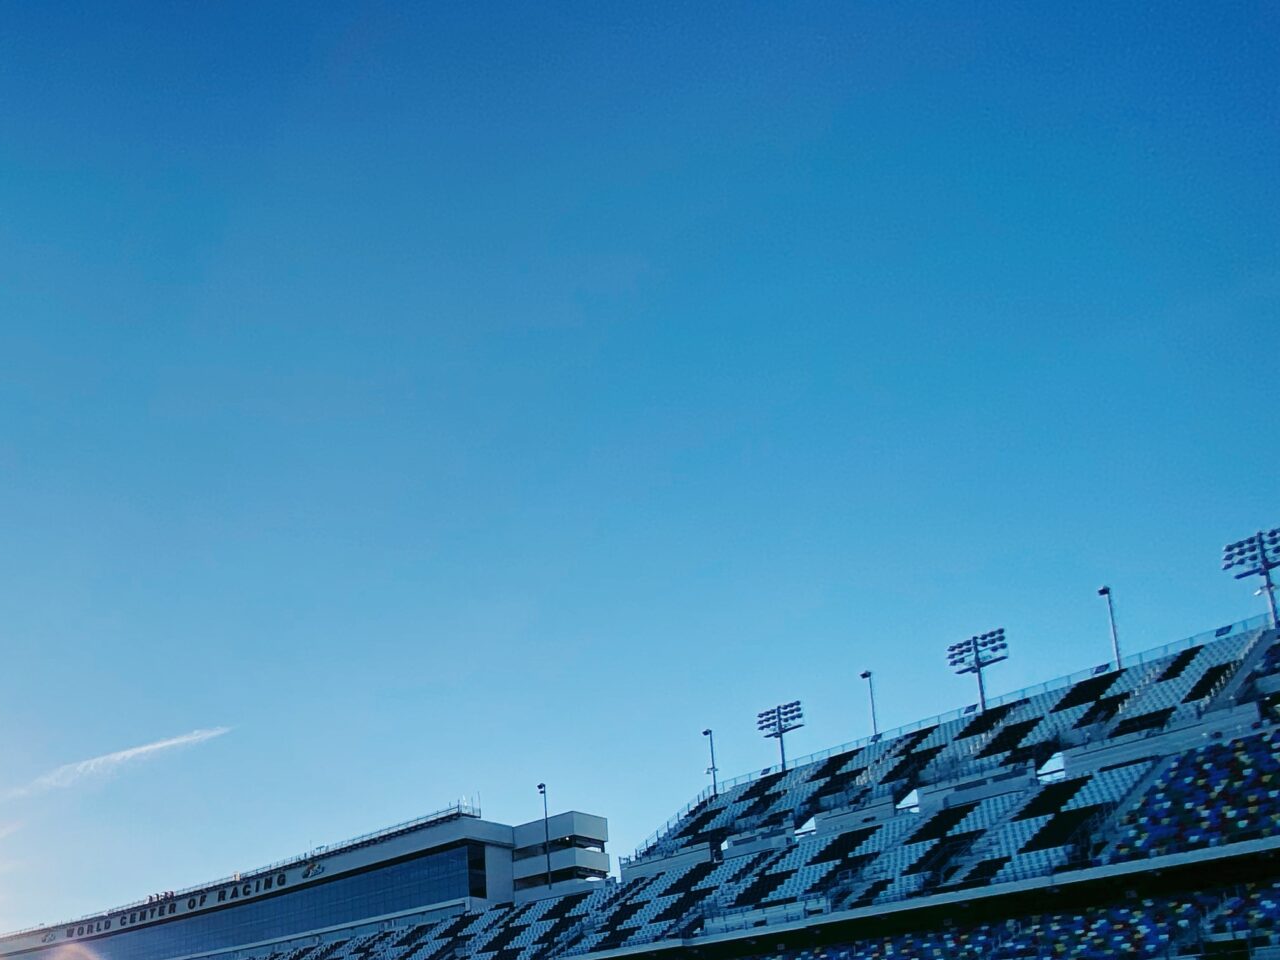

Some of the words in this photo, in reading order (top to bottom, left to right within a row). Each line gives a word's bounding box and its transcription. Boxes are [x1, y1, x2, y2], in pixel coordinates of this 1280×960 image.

[66, 919, 112, 938] WORLD
[120, 902, 177, 925] CENTER
[187, 894, 208, 910] OF
[217, 872, 287, 903] RACING
